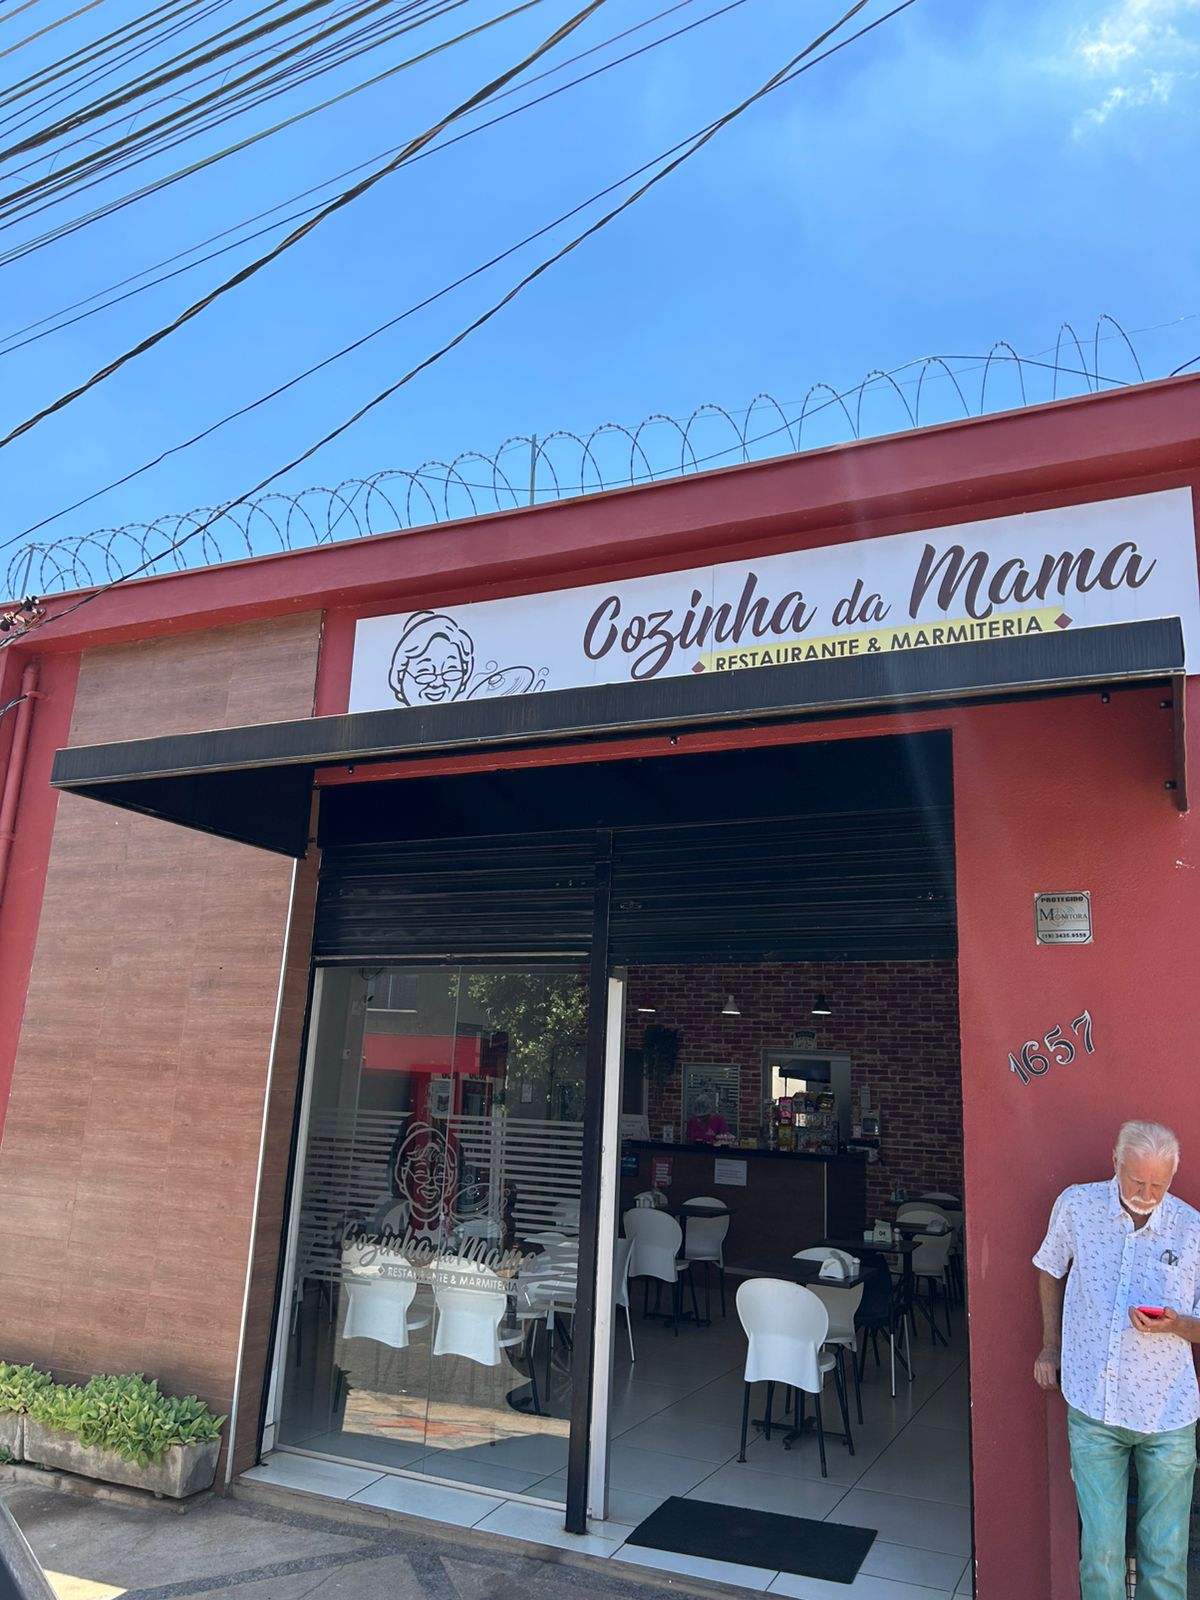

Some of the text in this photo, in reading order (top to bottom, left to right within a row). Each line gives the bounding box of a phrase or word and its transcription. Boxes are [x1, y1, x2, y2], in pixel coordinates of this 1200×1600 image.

[584, 541, 1157, 681] Cozinha da Mama
[715, 616, 1044, 671] RESTAURANTE & MARMITERIA
[1040, 895, 1084, 904] PROTEGIDO
[1008, 1010, 1095, 1086] 1657
[340, 1222, 435, 1267] Cozinha
[450, 1274, 458, 1285] &
[459, 1276, 519, 1293] MARMITERIA
